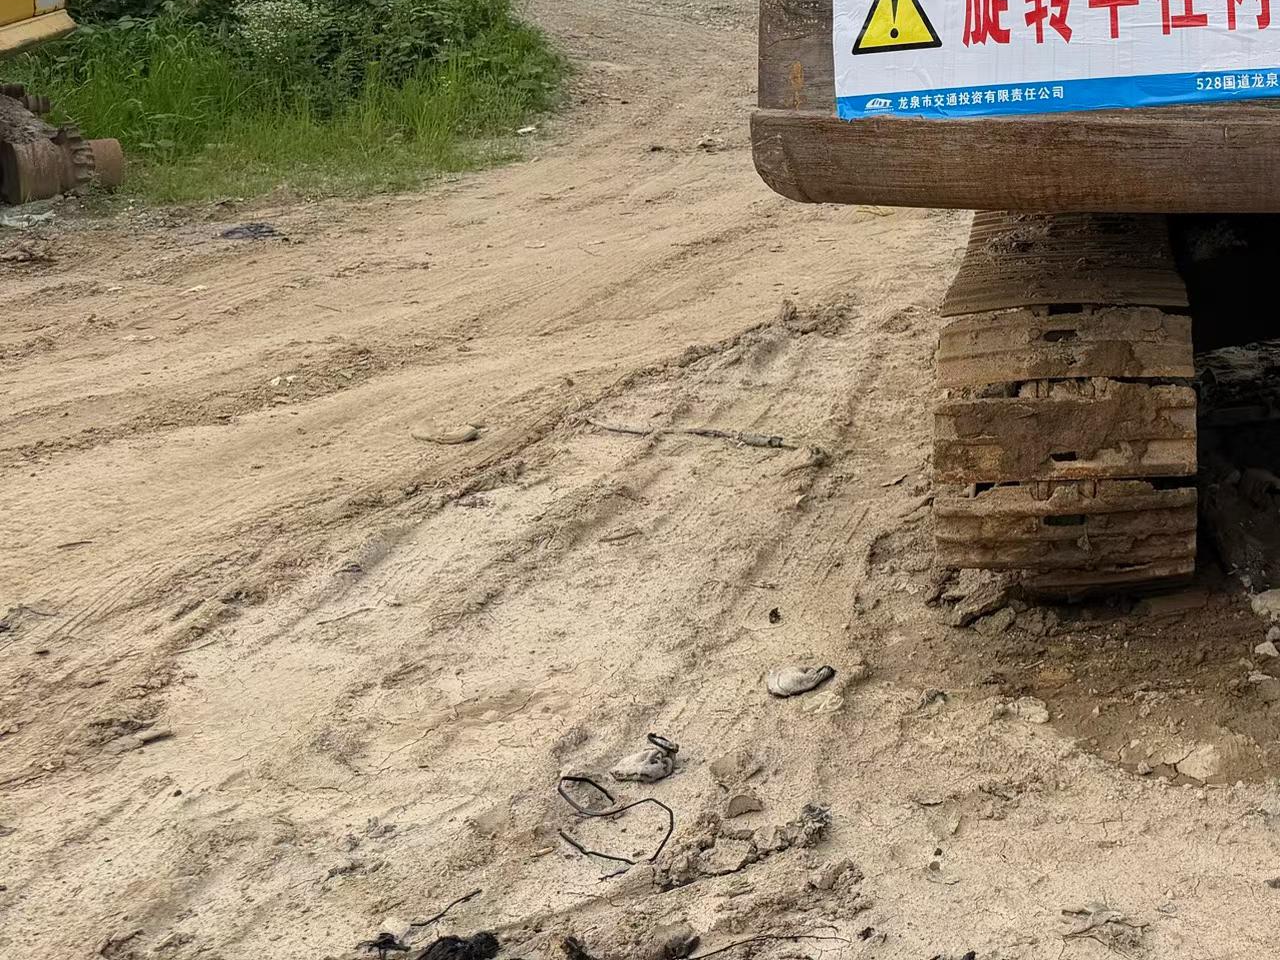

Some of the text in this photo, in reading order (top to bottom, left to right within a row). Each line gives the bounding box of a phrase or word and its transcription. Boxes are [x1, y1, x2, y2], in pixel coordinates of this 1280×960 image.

[898, 85, 1064, 110] 龙泉市交通投资有限责任公司
